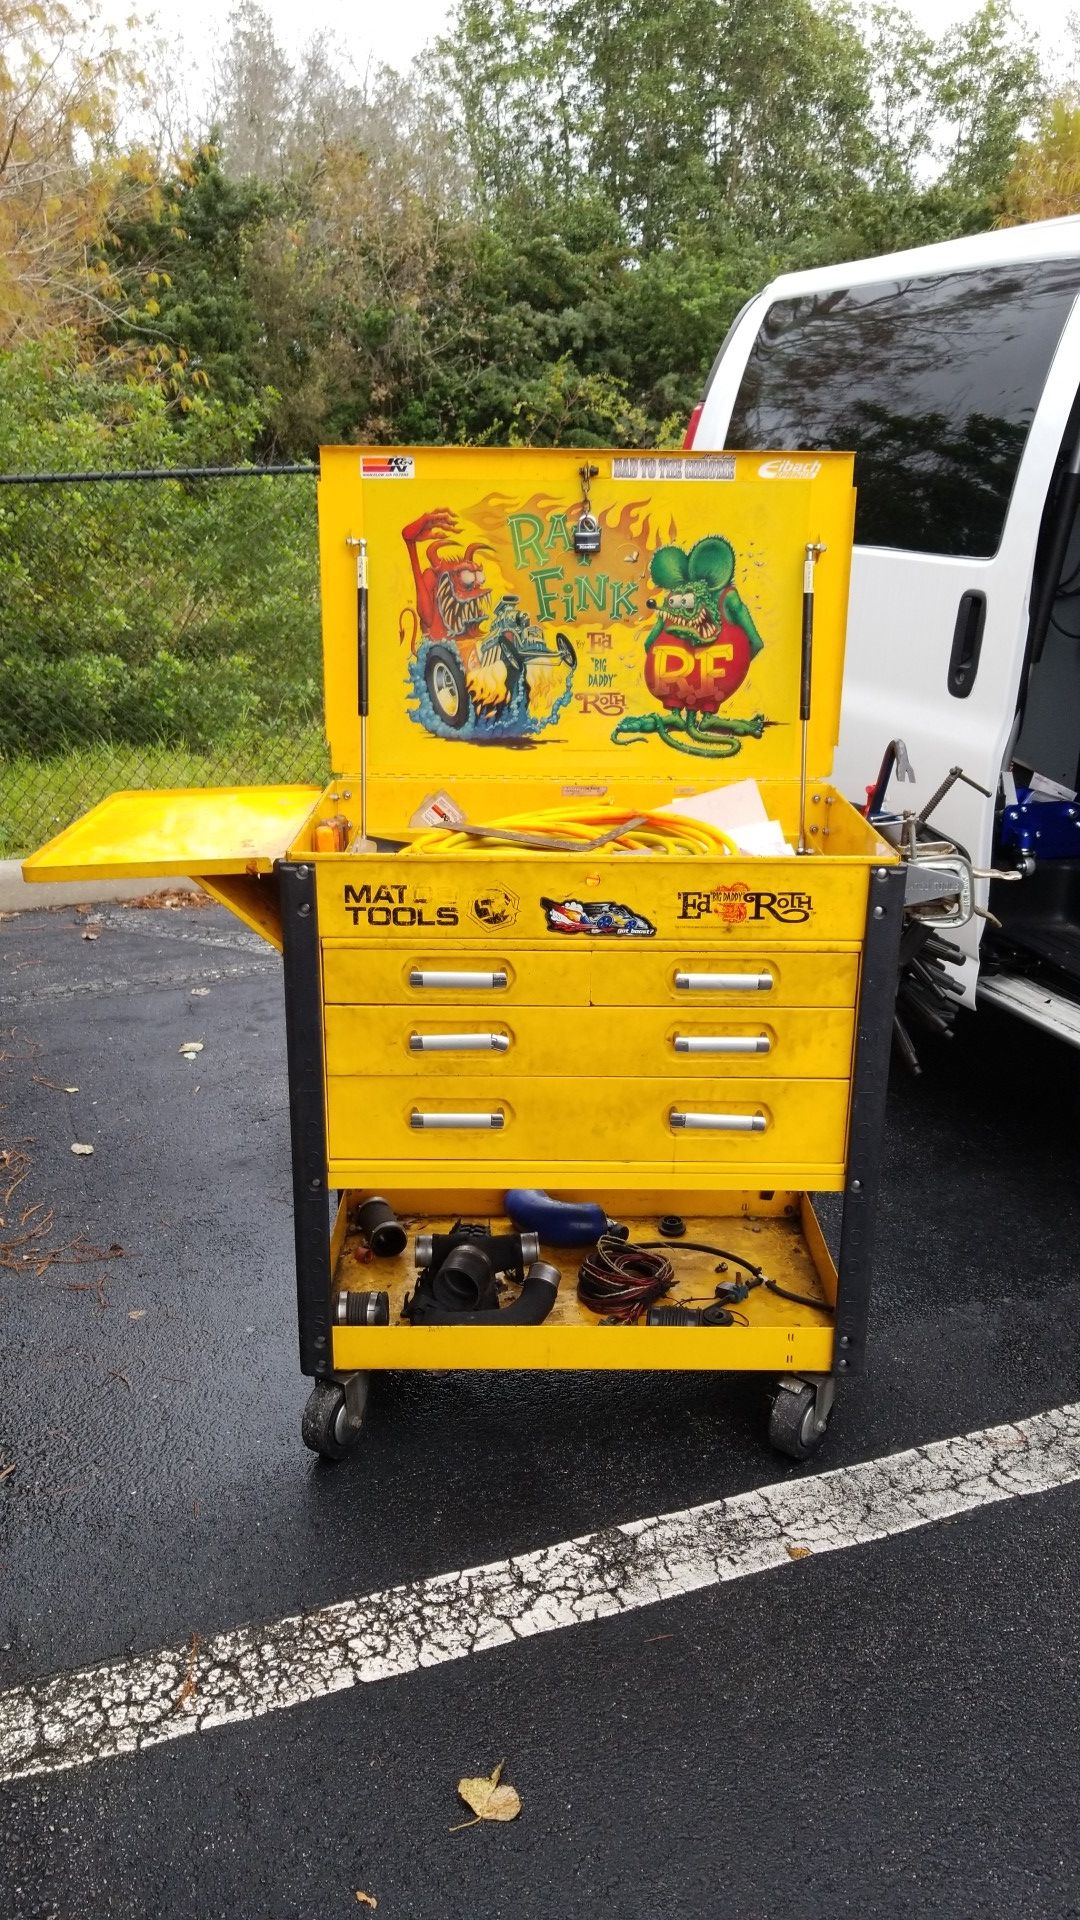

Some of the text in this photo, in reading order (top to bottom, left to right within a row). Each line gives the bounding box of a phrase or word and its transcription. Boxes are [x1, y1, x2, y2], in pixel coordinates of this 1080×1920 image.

[640, 459, 657, 478] TO
[758, 459, 821, 479] Eibach
[345, 906, 459, 927] TOOLS
